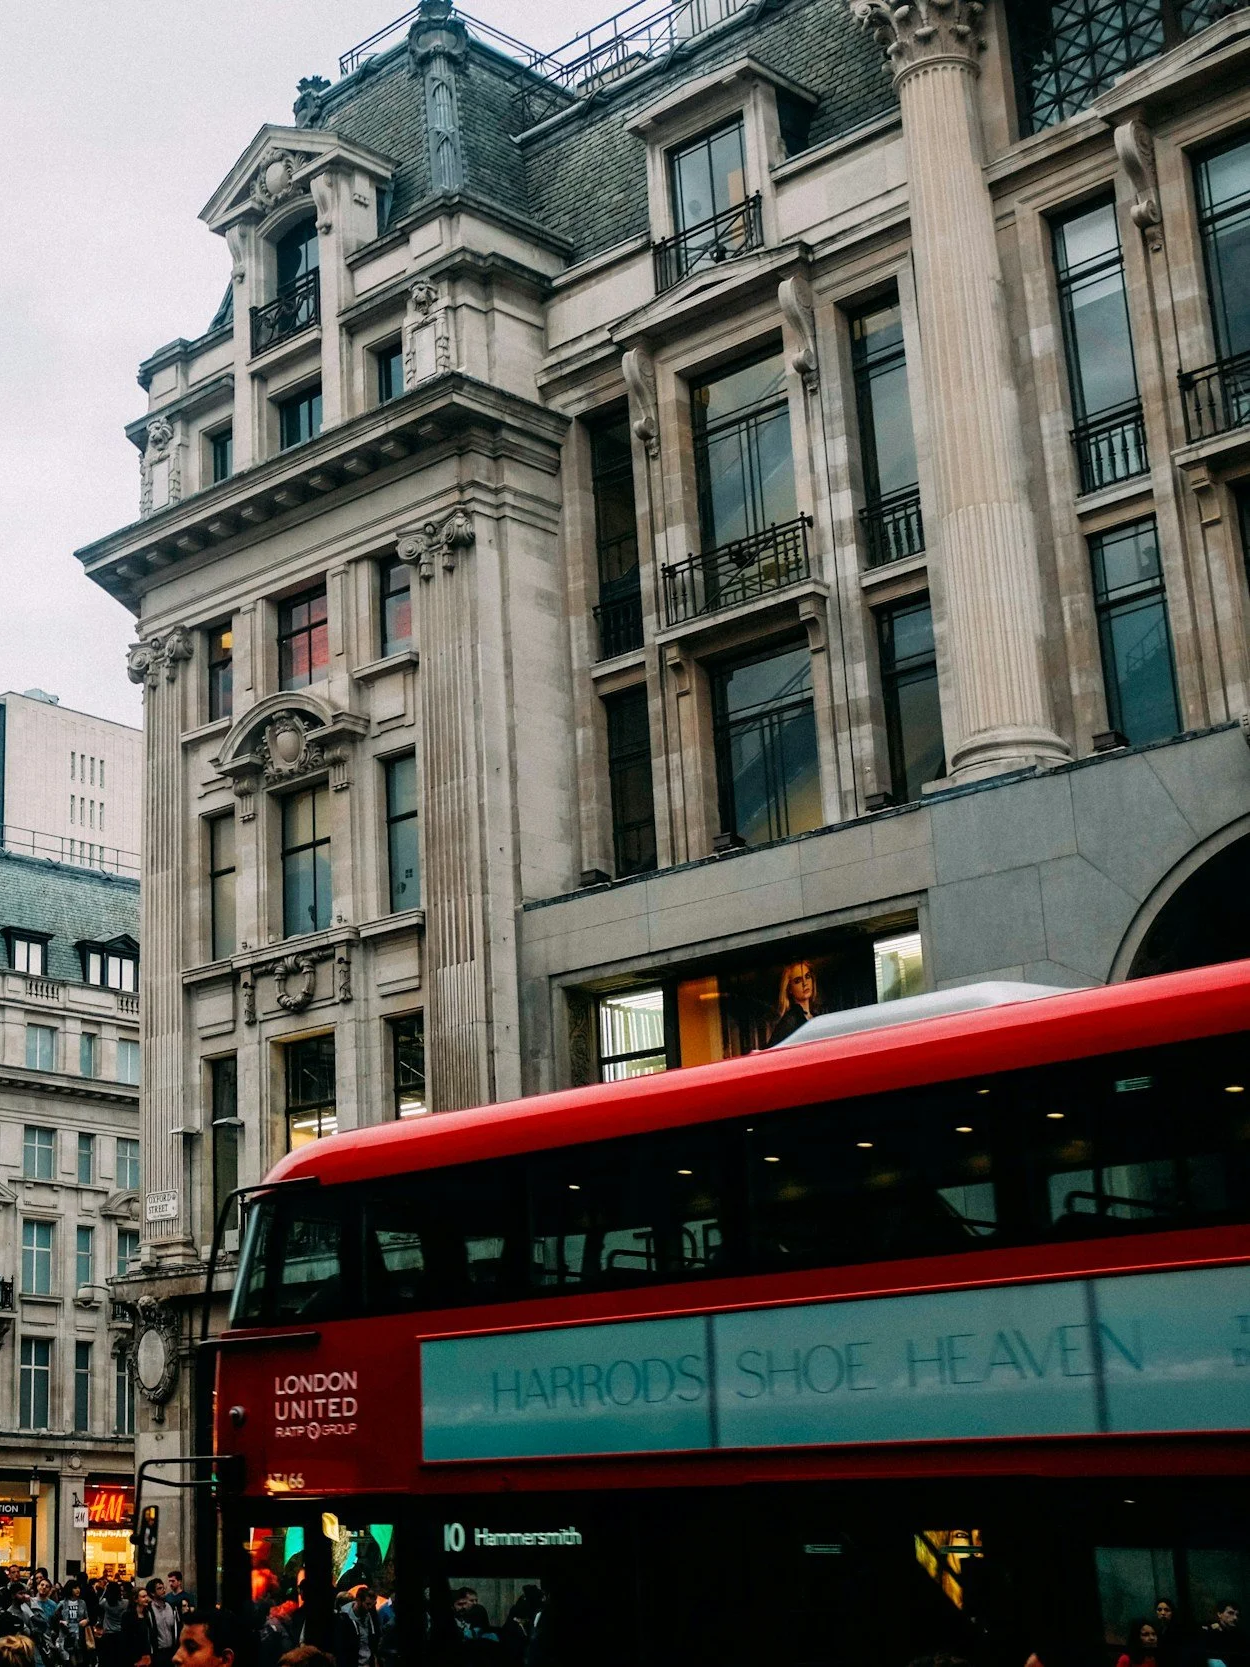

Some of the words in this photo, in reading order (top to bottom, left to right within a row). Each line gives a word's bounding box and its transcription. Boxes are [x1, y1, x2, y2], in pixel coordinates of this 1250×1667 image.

[149, 1194, 171, 1204] OXFORD
[149, 1204, 168, 1214] STREET
[492, 1354, 705, 1412] HARRODS
[736, 1342, 877, 1399] SHOE
[905, 1320, 1144, 1388] HEAVEN
[275, 1371, 358, 1395] LONDON
[275, 1397, 358, 1420] UNITED
[275, 1426, 305, 1437] RATP
[321, 1423, 357, 1436] GROUP
[90, 1493, 125, 1523] H&M
[444, 1522, 466, 1552] 10
[474, 1525, 582, 1546] Hammersmith
